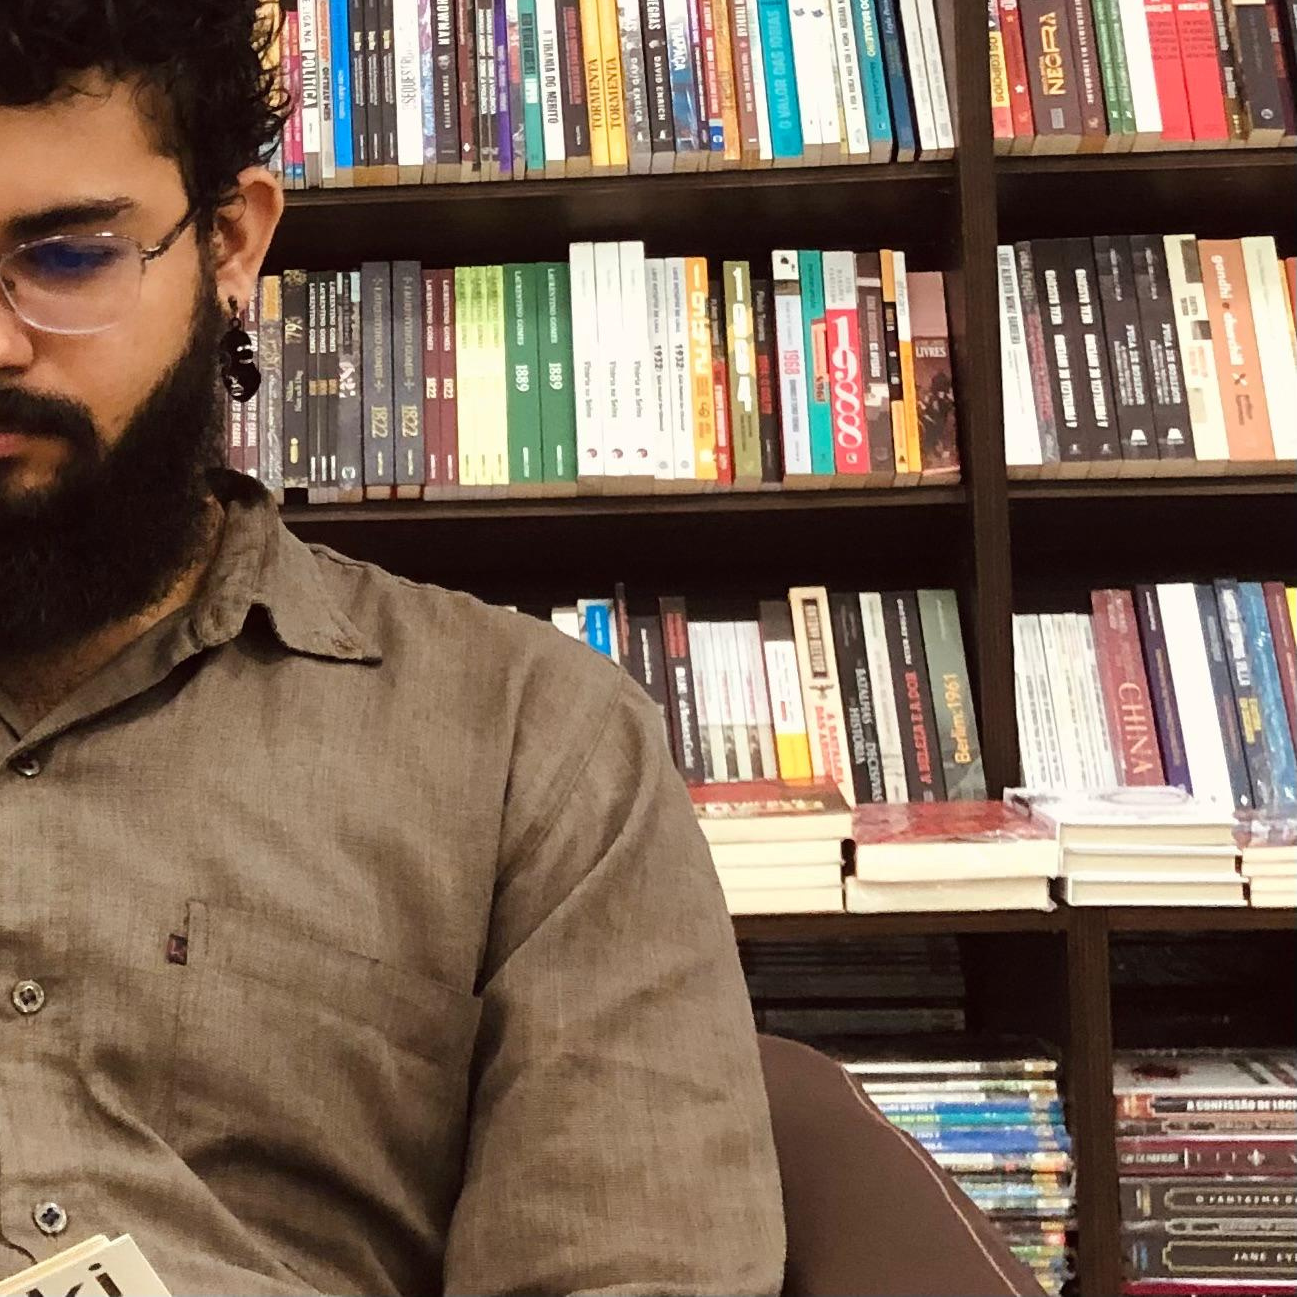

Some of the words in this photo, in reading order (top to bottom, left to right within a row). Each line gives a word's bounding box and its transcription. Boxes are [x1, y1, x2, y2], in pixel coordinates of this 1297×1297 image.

[671, 22, 688, 71] TRAPAÇA
[990, 36, 998, 50] OS
[630, 58, 641, 85] DAVID
[654, 56, 663, 83] DAVID
[991, 54, 1005, 102] EGÍPCIOS
[588, 58, 602, 131] TORMENTA
[605, 57, 621, 130] TORMENTA
[774, 80, 790, 118] VALOR
[547, 268, 556, 315] LAURENTINO
[1210, 254, 1233, 298] gandhi
[515, 271, 523, 317] LAURENTINO
[516, 319, 524, 345] GOMES
[550, 317, 558, 344] GOMES
[515, 364, 529, 391] 1889
[549, 362, 562, 389] 1889
[783, 350, 800, 374] 1968
[371, 405, 388, 438] 1822
[401, 404, 418, 437] 1822
[905, 671, 919, 699] DOR
[943, 673, 961, 709] 1961
[1118, 682, 1154, 774] CHINA
